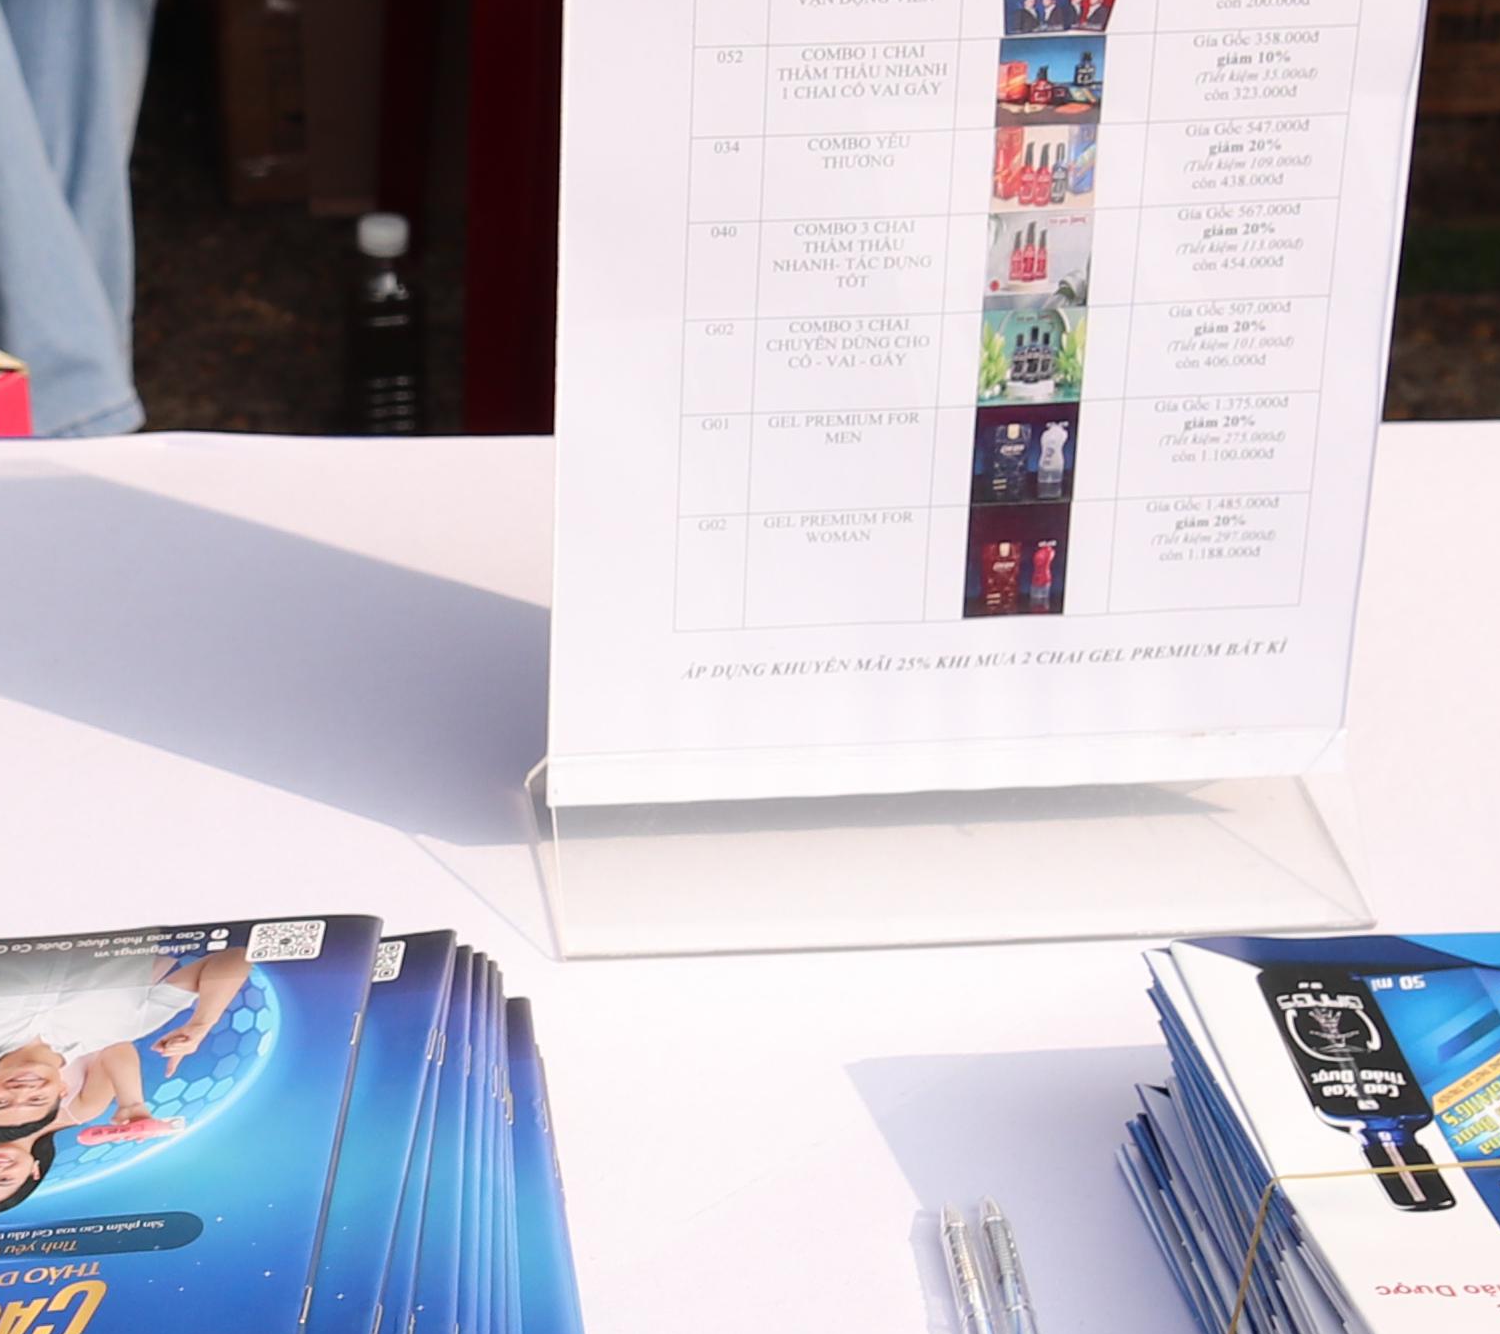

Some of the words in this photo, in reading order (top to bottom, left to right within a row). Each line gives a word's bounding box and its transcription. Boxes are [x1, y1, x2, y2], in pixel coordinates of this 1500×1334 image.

[1370, 979, 1393, 993] ml
[1399, 975, 1426, 991] 50
[24, 1262, 101, 1284] THẢO
[1374, 1283, 1456, 1299] Dược
